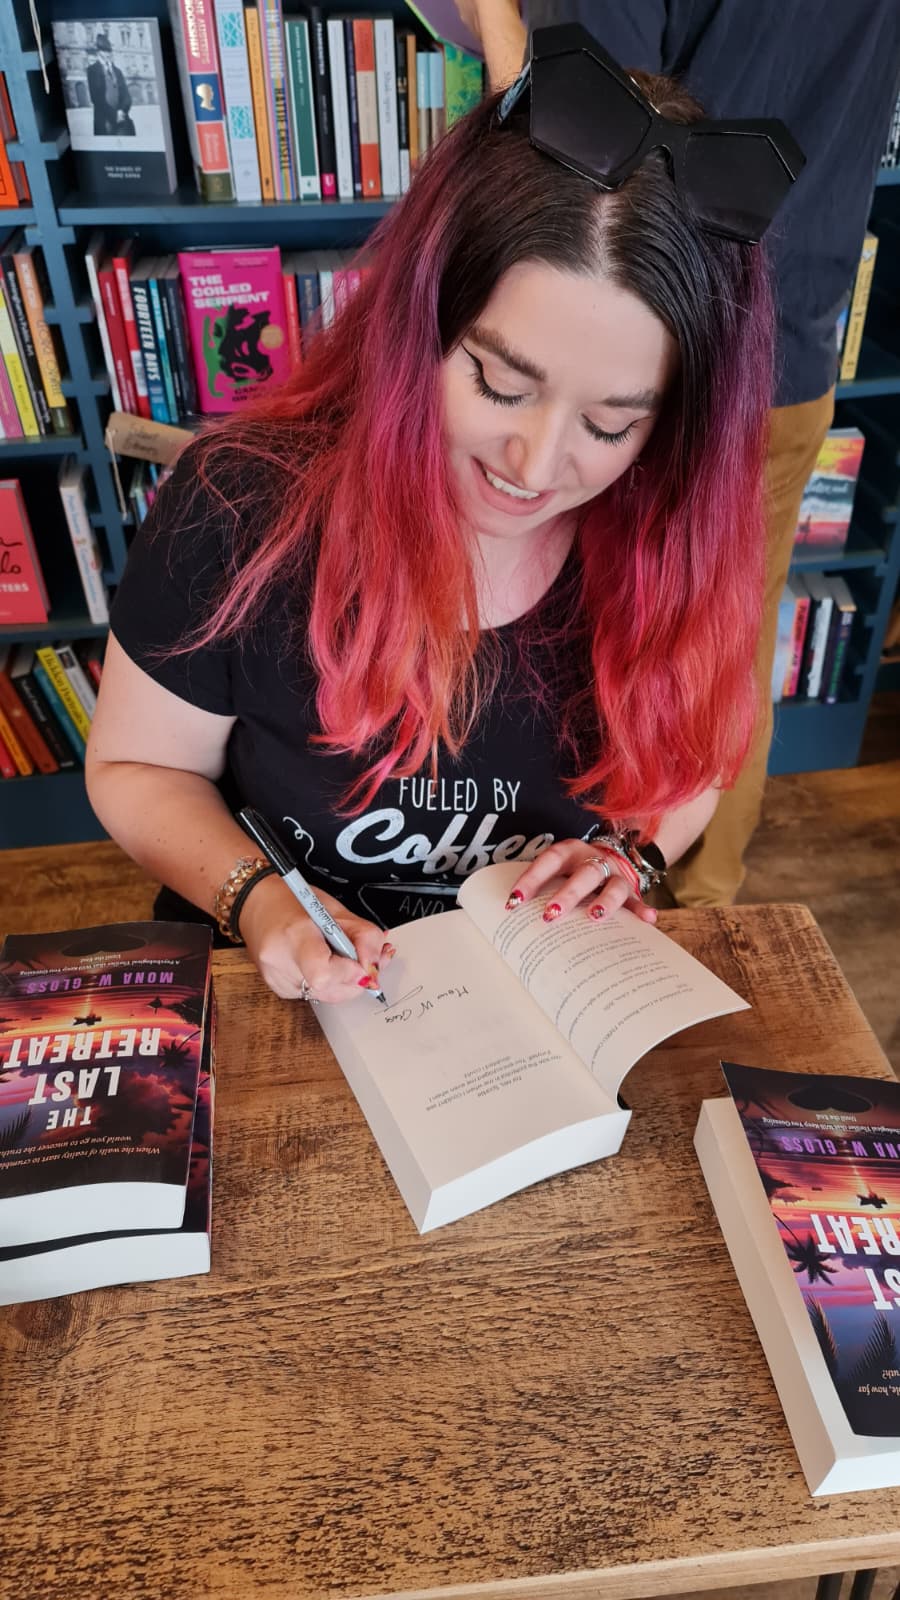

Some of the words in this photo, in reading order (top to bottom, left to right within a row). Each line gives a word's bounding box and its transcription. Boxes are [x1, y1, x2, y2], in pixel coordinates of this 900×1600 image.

[267, 28, 284, 80] WRITING
[188, 274, 222, 286] THE
[191, 282, 252, 298] COILED
[193, 291, 270, 309] SERPENT
[133, 286, 156, 350] FOURTEEN
[146, 352, 160, 381] DAYS
[398, 777, 478, 812] FUELED
[493, 778, 521, 812] BY
[334, 808, 554, 875] Coffee
[123, 972, 174, 984] MONA
[25, 978, 82, 994] GLOSS
[2, 1028, 161, 1069] RETREAT
[28, 1066, 121, 1106] LAST
[46, 1106, 92, 1130] THE
[762, 1116, 790, 1126] Guessing
[804, 1121, 820, 1130] Keep
[848, 1125, 871, 1133] Thriller
[37, 1142, 68, 1150] uncover
[107, 1136, 132, 1144] would
[780, 1136, 837, 1155] GLOSS
[22, 1146, 36, 1154] the
[89, 1148, 98, 1156] of
[100, 1148, 120, 1156] walls
[136, 1146, 160, 1154] When
[842, 1140, 868, 1157] W.
[32, 1156, 40, 1164] to
[42, 1154, 60, 1162] start
[62, 1150, 88, 1160] reality
[858, 1384, 870, 1396] far
[871, 1386, 888, 1396] how
